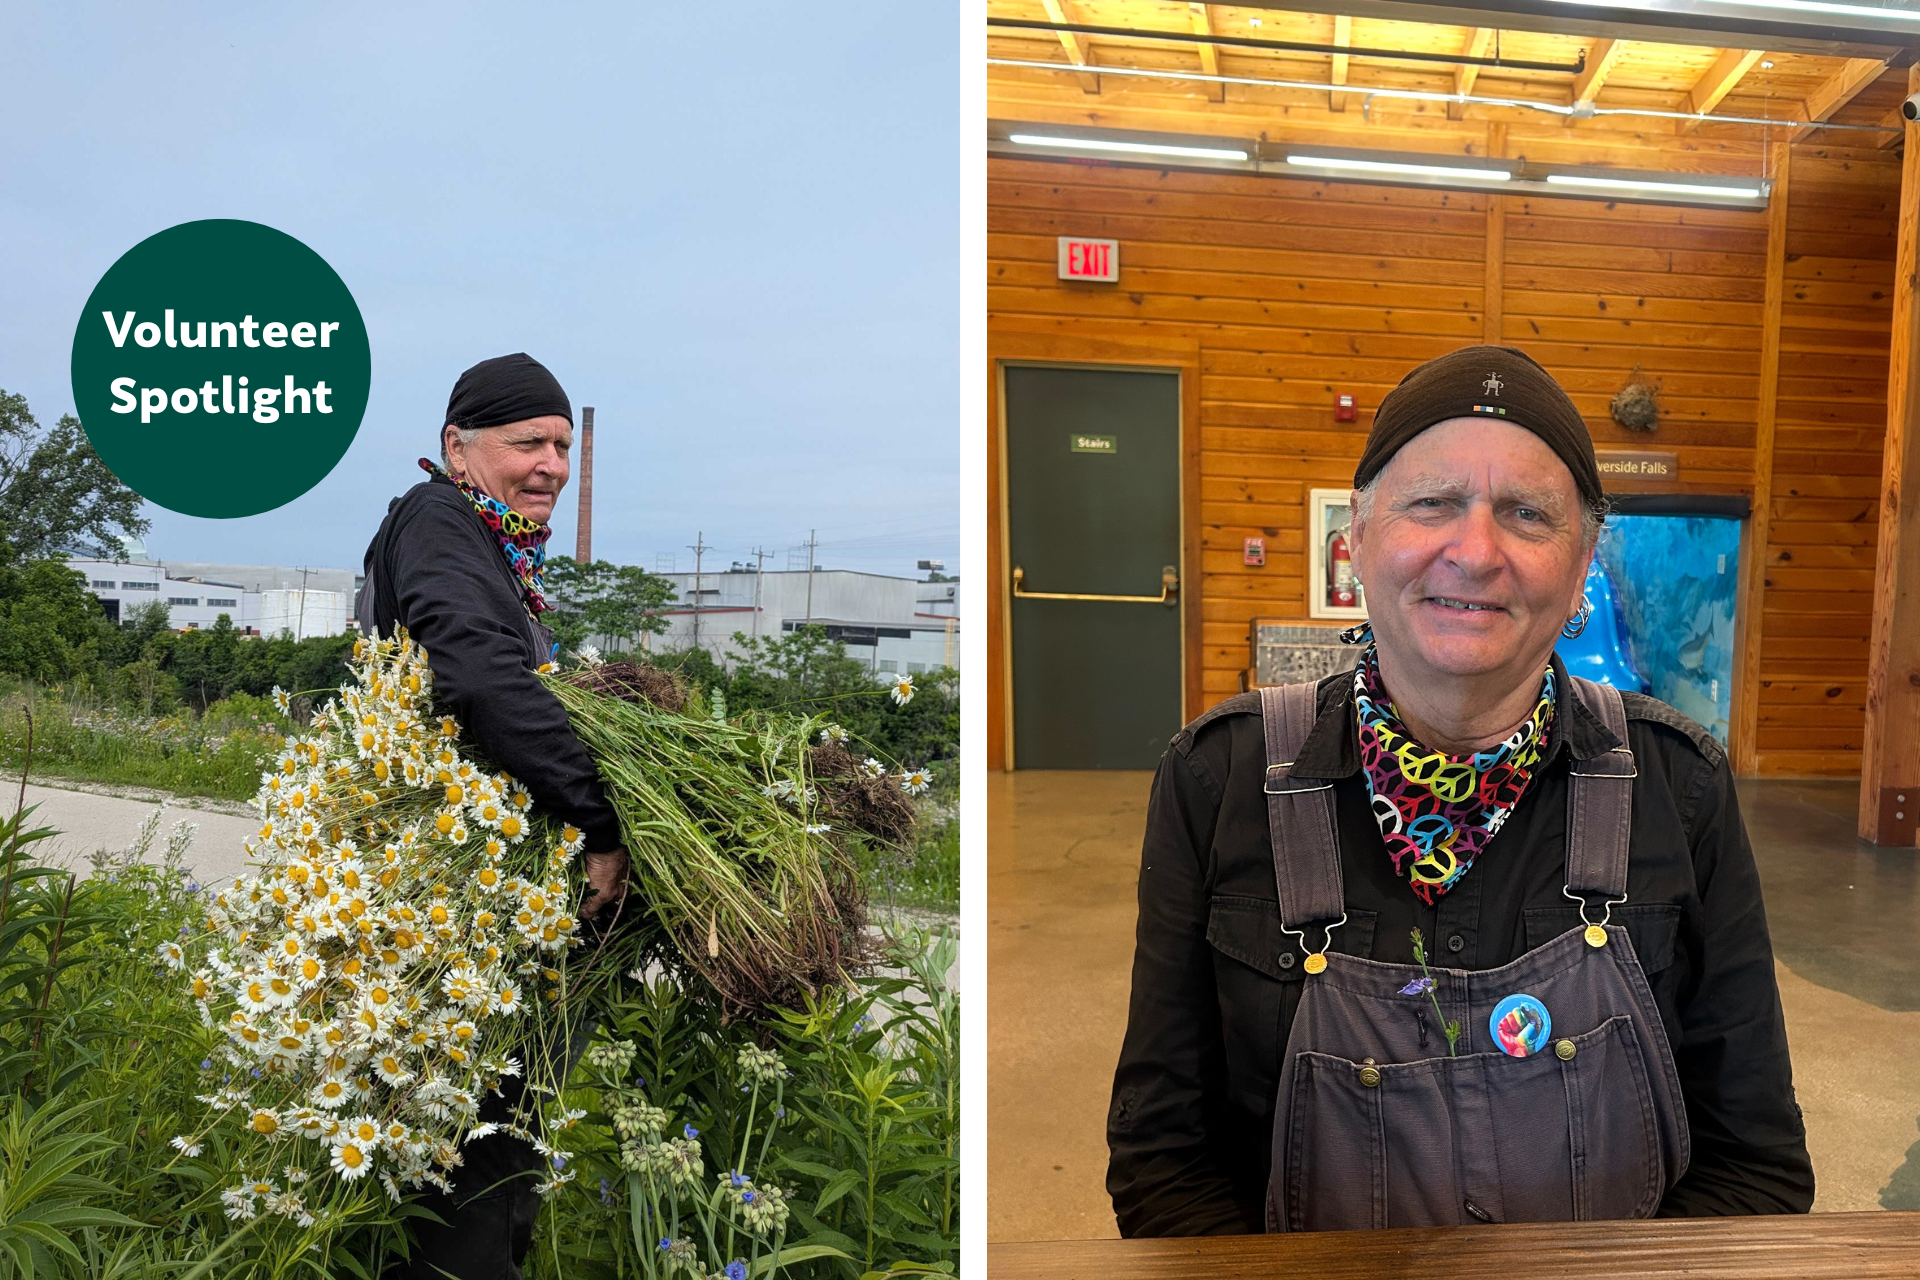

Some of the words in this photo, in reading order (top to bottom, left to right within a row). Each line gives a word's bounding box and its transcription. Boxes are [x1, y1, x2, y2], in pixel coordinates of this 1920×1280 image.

[1068, 242, 1111, 277] EXIT
[1077, 437, 1111, 449] Stairs
[1640, 461, 1668, 475] Falls
